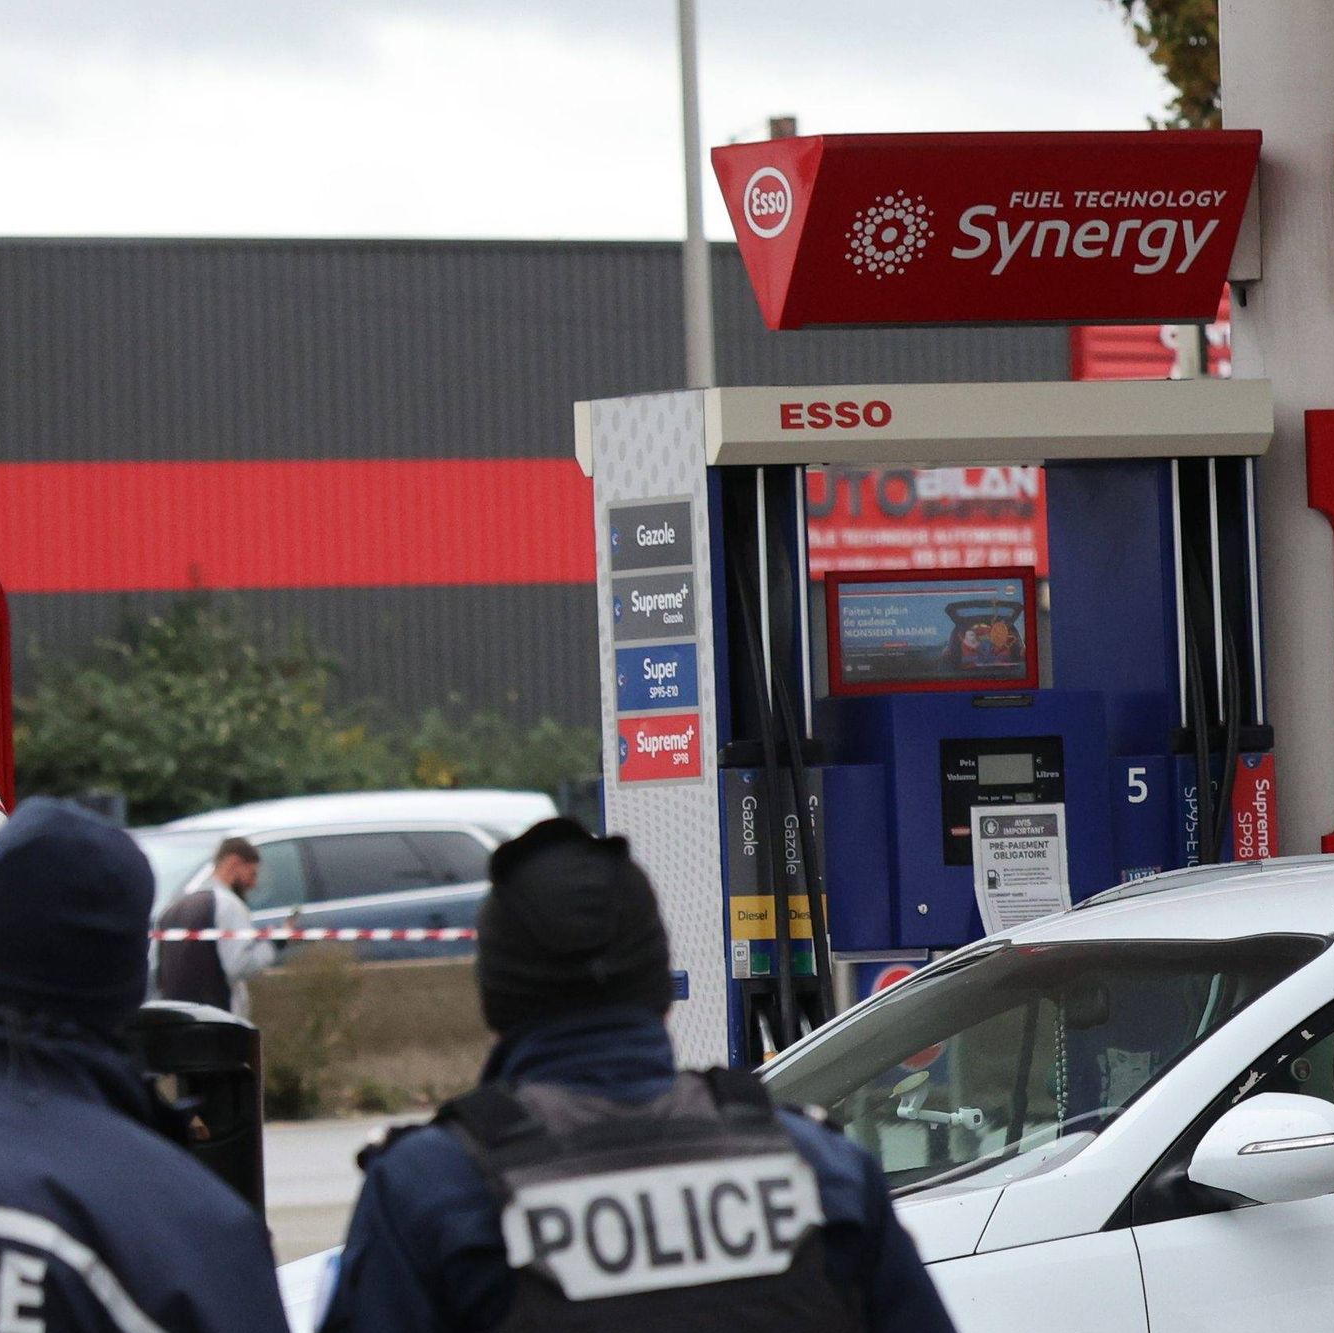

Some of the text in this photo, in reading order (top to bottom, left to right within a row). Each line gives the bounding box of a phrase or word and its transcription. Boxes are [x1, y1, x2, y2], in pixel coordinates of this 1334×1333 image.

[751, 187, 786, 216] Esso
[1009, 189, 1227, 208] FUEL TECHNOLOGY
[951, 205, 1220, 275] Synergy
[780, 400, 892, 430] ESSO
[637, 522, 675, 546] Gazole
[631, 584, 688, 617] Supreme+
[643, 658, 678, 685] Super
[637, 725, 694, 758] Supreme+
[1128, 767, 1148, 804] 5
[742, 795, 759, 856] Gazole
[1238, 812, 1254, 858] SP98
[784, 814, 800, 875] Gazole
[989, 840, 1050, 850] PRÉ-PAIEMENT
[994, 849, 1047, 860] OBLIGATOIRE
[738, 909, 768, 921] Diesel
[526, 1176, 797, 1276] POLICE
